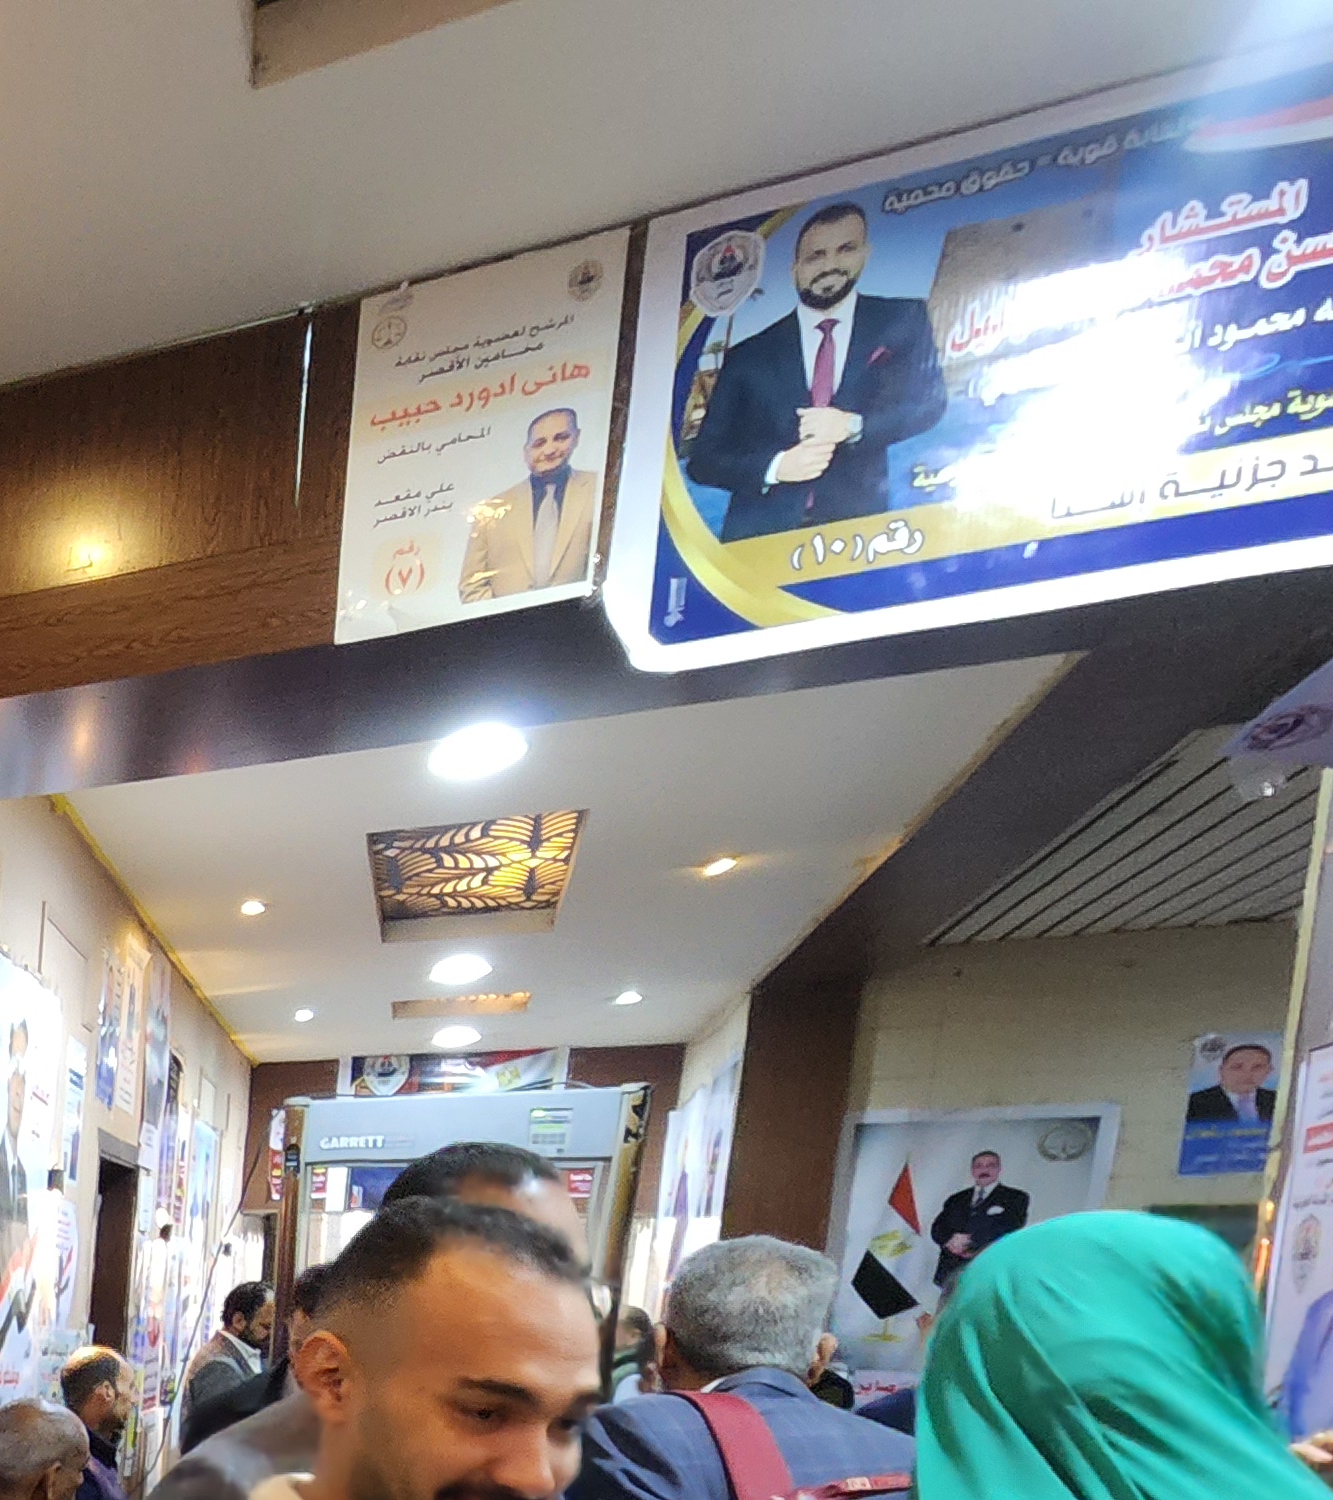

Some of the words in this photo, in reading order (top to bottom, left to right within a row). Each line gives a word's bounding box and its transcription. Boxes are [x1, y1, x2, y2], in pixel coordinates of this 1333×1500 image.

[1140, 178, 1309, 257] المستشار
[1259, 229, 1333, 289] سن
[472, 326, 526, 347] لعضوية
[529, 313, 575, 339] المرشح
[1207, 307, 1306, 351] محمود
[394, 351, 426, 368] نقابة
[429, 342, 470, 362] مجلس
[474, 341, 545, 370] محامين
[418, 355, 470, 384] الأقصر
[448, 372, 517, 412] ادورد
[370, 398, 442, 431] حبيب
[1213, 402, 1281, 436] مجلس
[377, 442, 433, 465] بالنقض
[435, 426, 492, 453] المحامي
[374, 488, 422, 507] مقعد
[424, 501, 454, 518] بندر
[866, 519, 925, 563] رقم
[384, 561, 425, 596] (٧)
[319, 1134, 385, 1150] GARRETT
